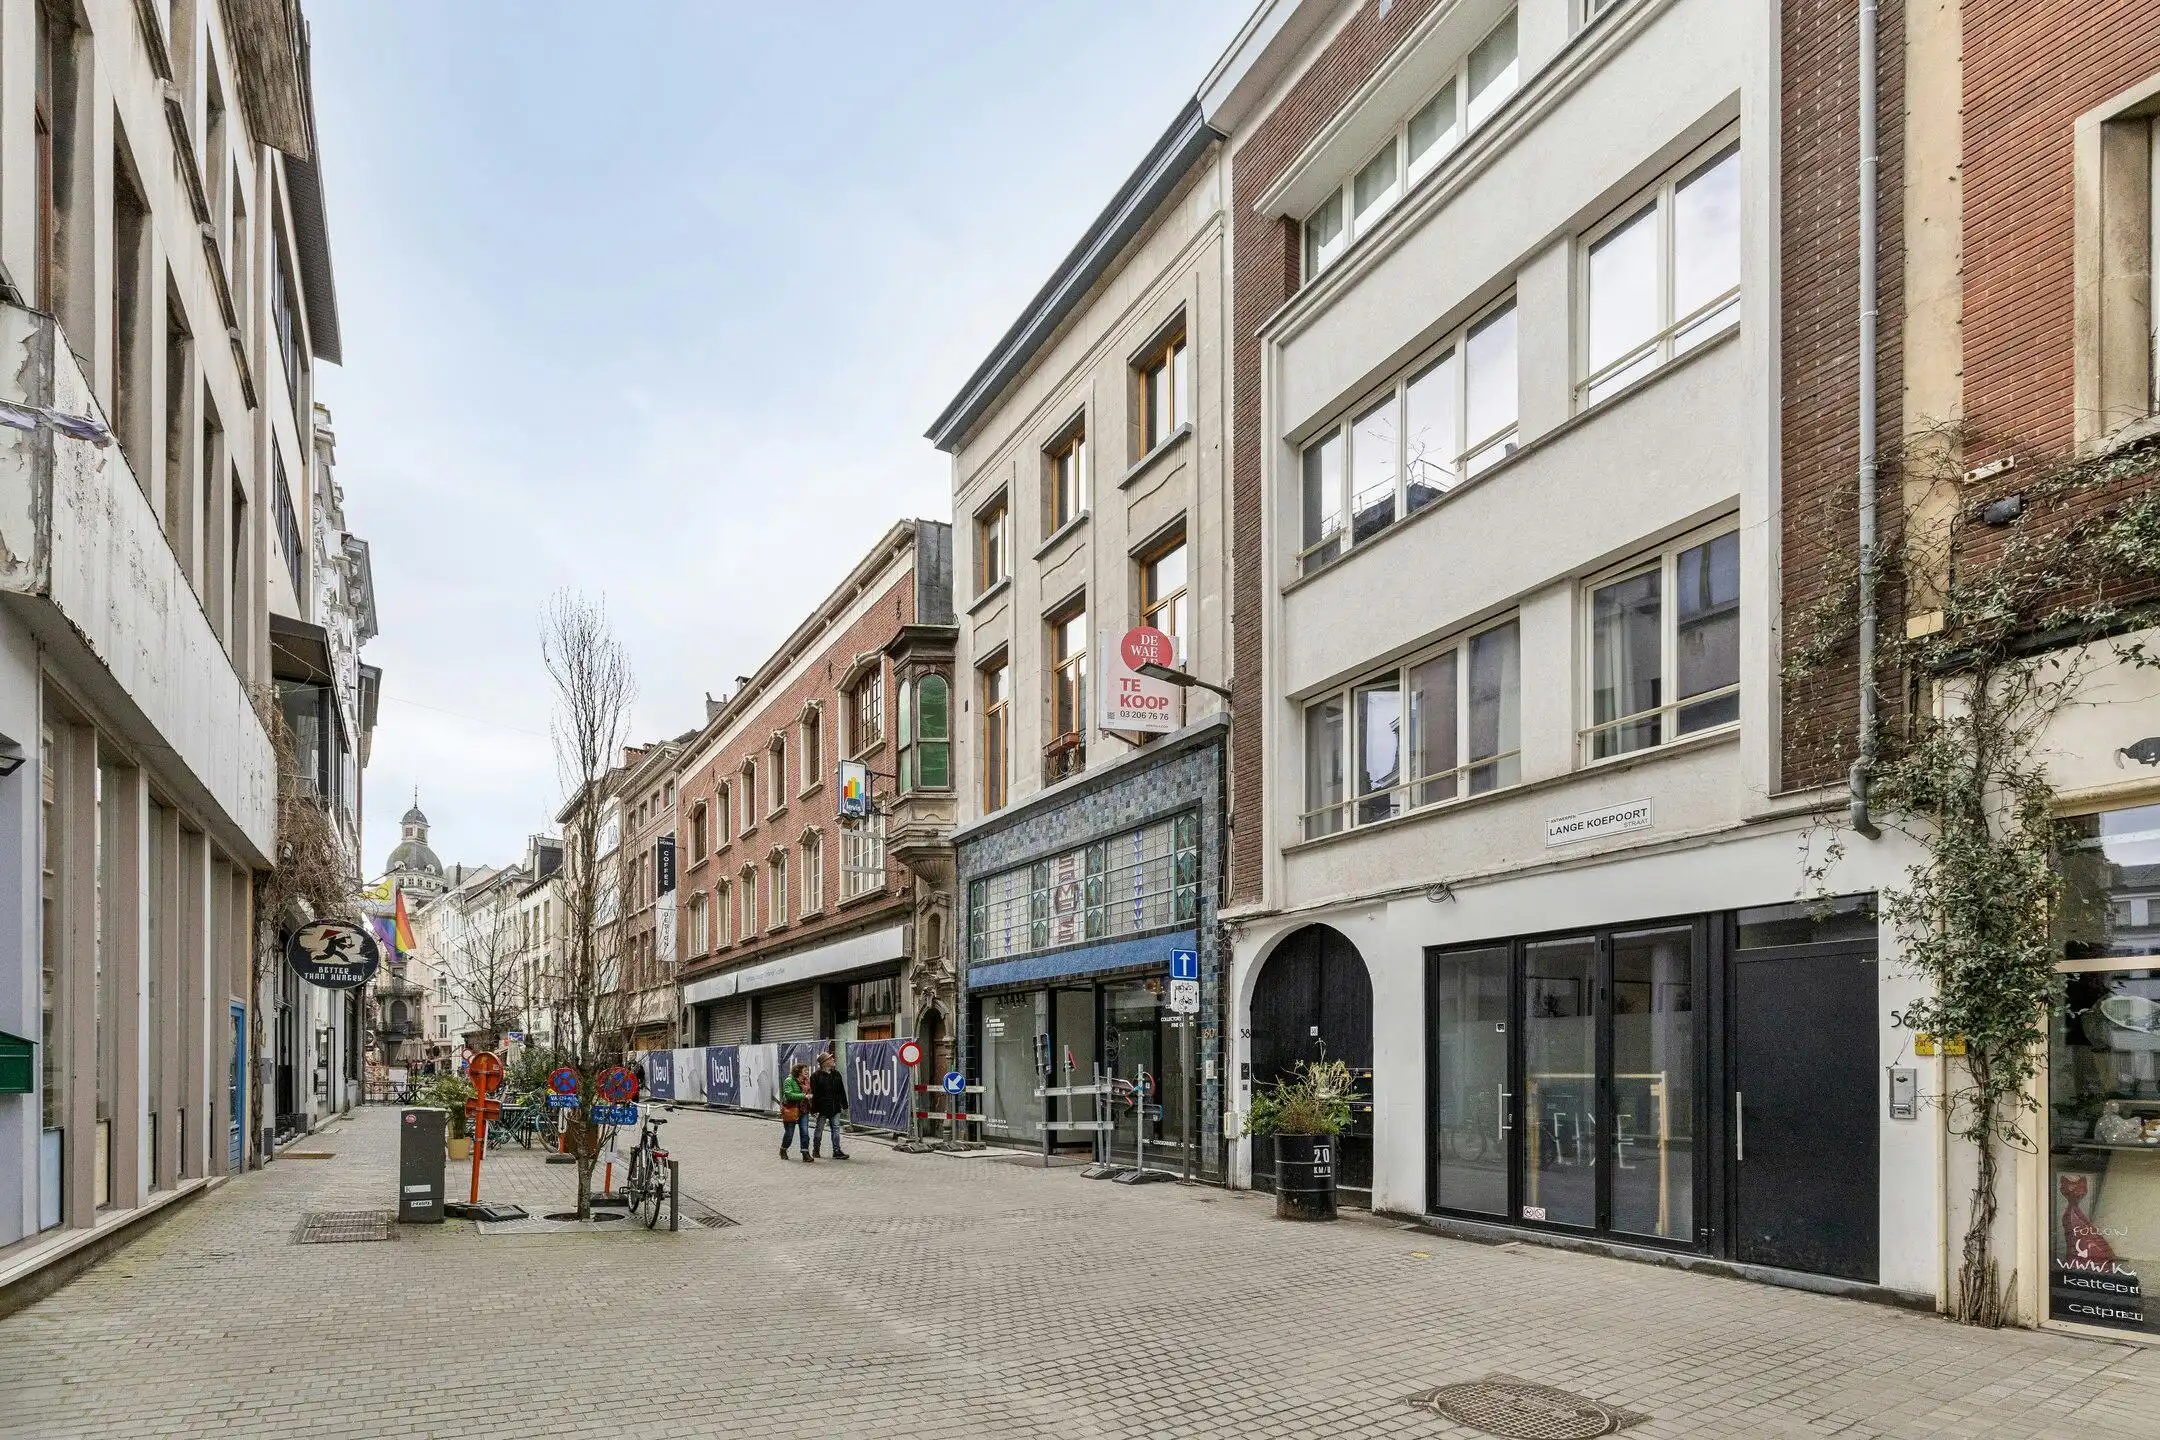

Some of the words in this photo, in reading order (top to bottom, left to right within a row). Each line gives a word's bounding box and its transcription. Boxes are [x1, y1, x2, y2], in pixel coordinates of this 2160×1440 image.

[1140, 634, 1158, 646] DE
[1130, 644, 1158, 658] WAE
[1120, 677, 1141, 692] TE
[1120, 693, 1169, 710] KOOP
[1120, 710, 1130, 718] 03
[1131, 711, 1147, 719] 206
[1148, 712, 1158, 720] 76
[1159, 713, 1169, 721] 76
[1549, 821, 1584, 836] LANGE
[1586, 808, 1648, 828] KOEPOORT
[1550, 814, 1577, 824] ANTWERPEN
[1623, 818, 1649, 828] STRAAT
[318, 966, 349, 974] BETTER
[304, 972, 325, 980] THAN
[330, 974, 364, 982] HUNGRY
[1240, 1028, 1251, 1039] 58
[1313, 1148, 1330, 1163] 20
[2073, 1225, 2128, 1237] FOLLOW
